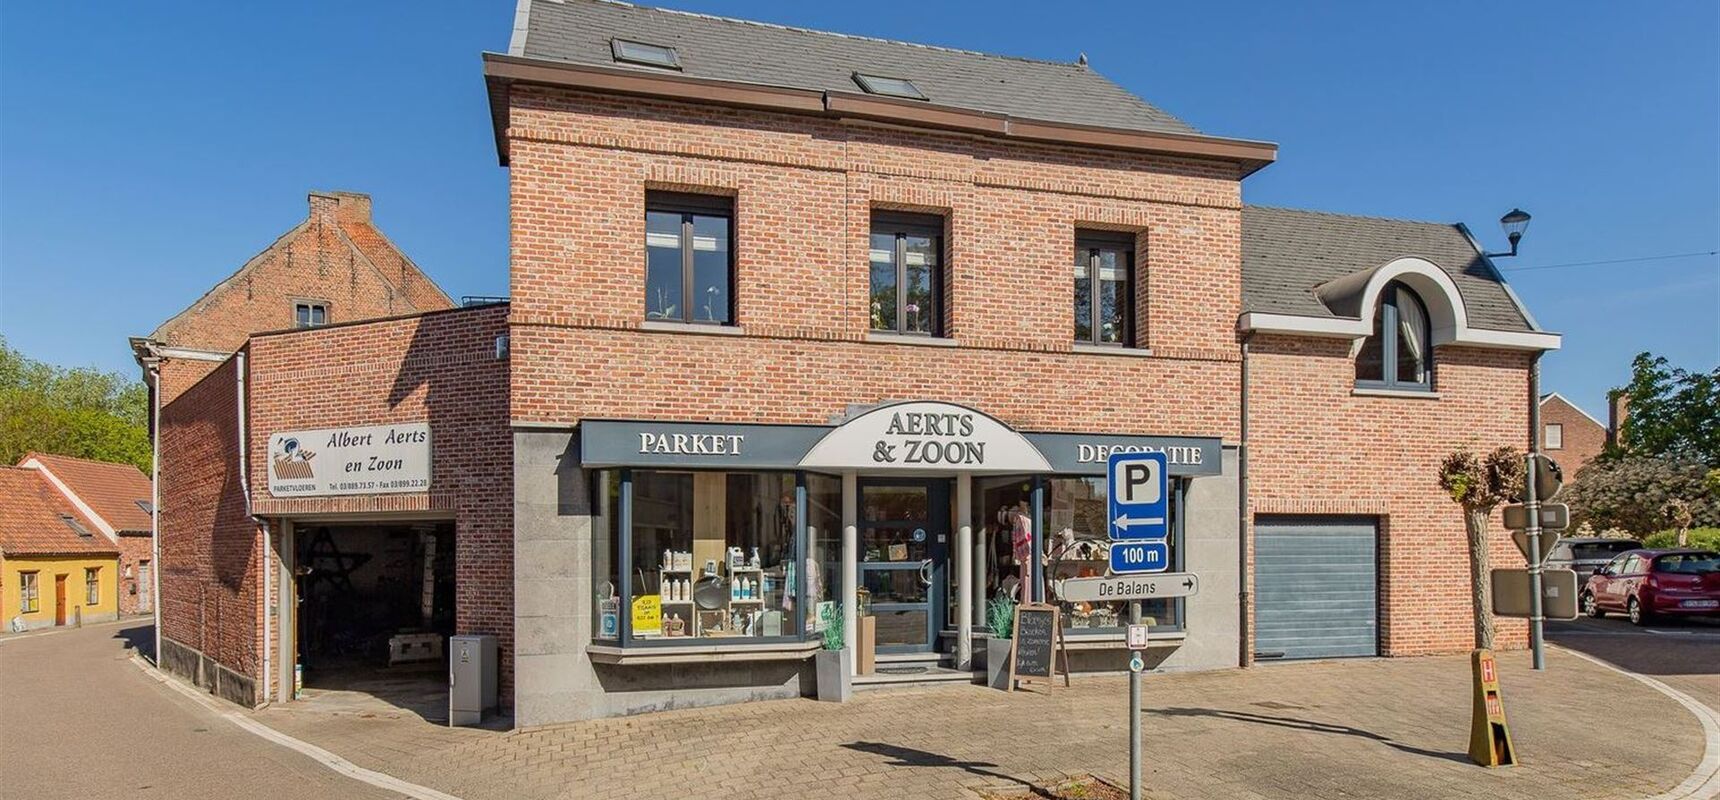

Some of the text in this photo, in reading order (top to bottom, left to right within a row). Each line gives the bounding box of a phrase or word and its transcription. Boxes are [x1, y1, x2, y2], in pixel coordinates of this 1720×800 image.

[885, 411, 974, 437] AERTS
[327, 428, 426, 448] Albert Aerts
[639, 432, 744, 456] PARKET
[872, 439, 986, 465] & ZOON
[345, 456, 403, 473] en Zoon
[379, 481, 389, 489] Fax
[1125, 463, 1150, 501] P
[1122, 547, 1159, 563] 100 m
[1099, 581, 1156, 596] De Balans
